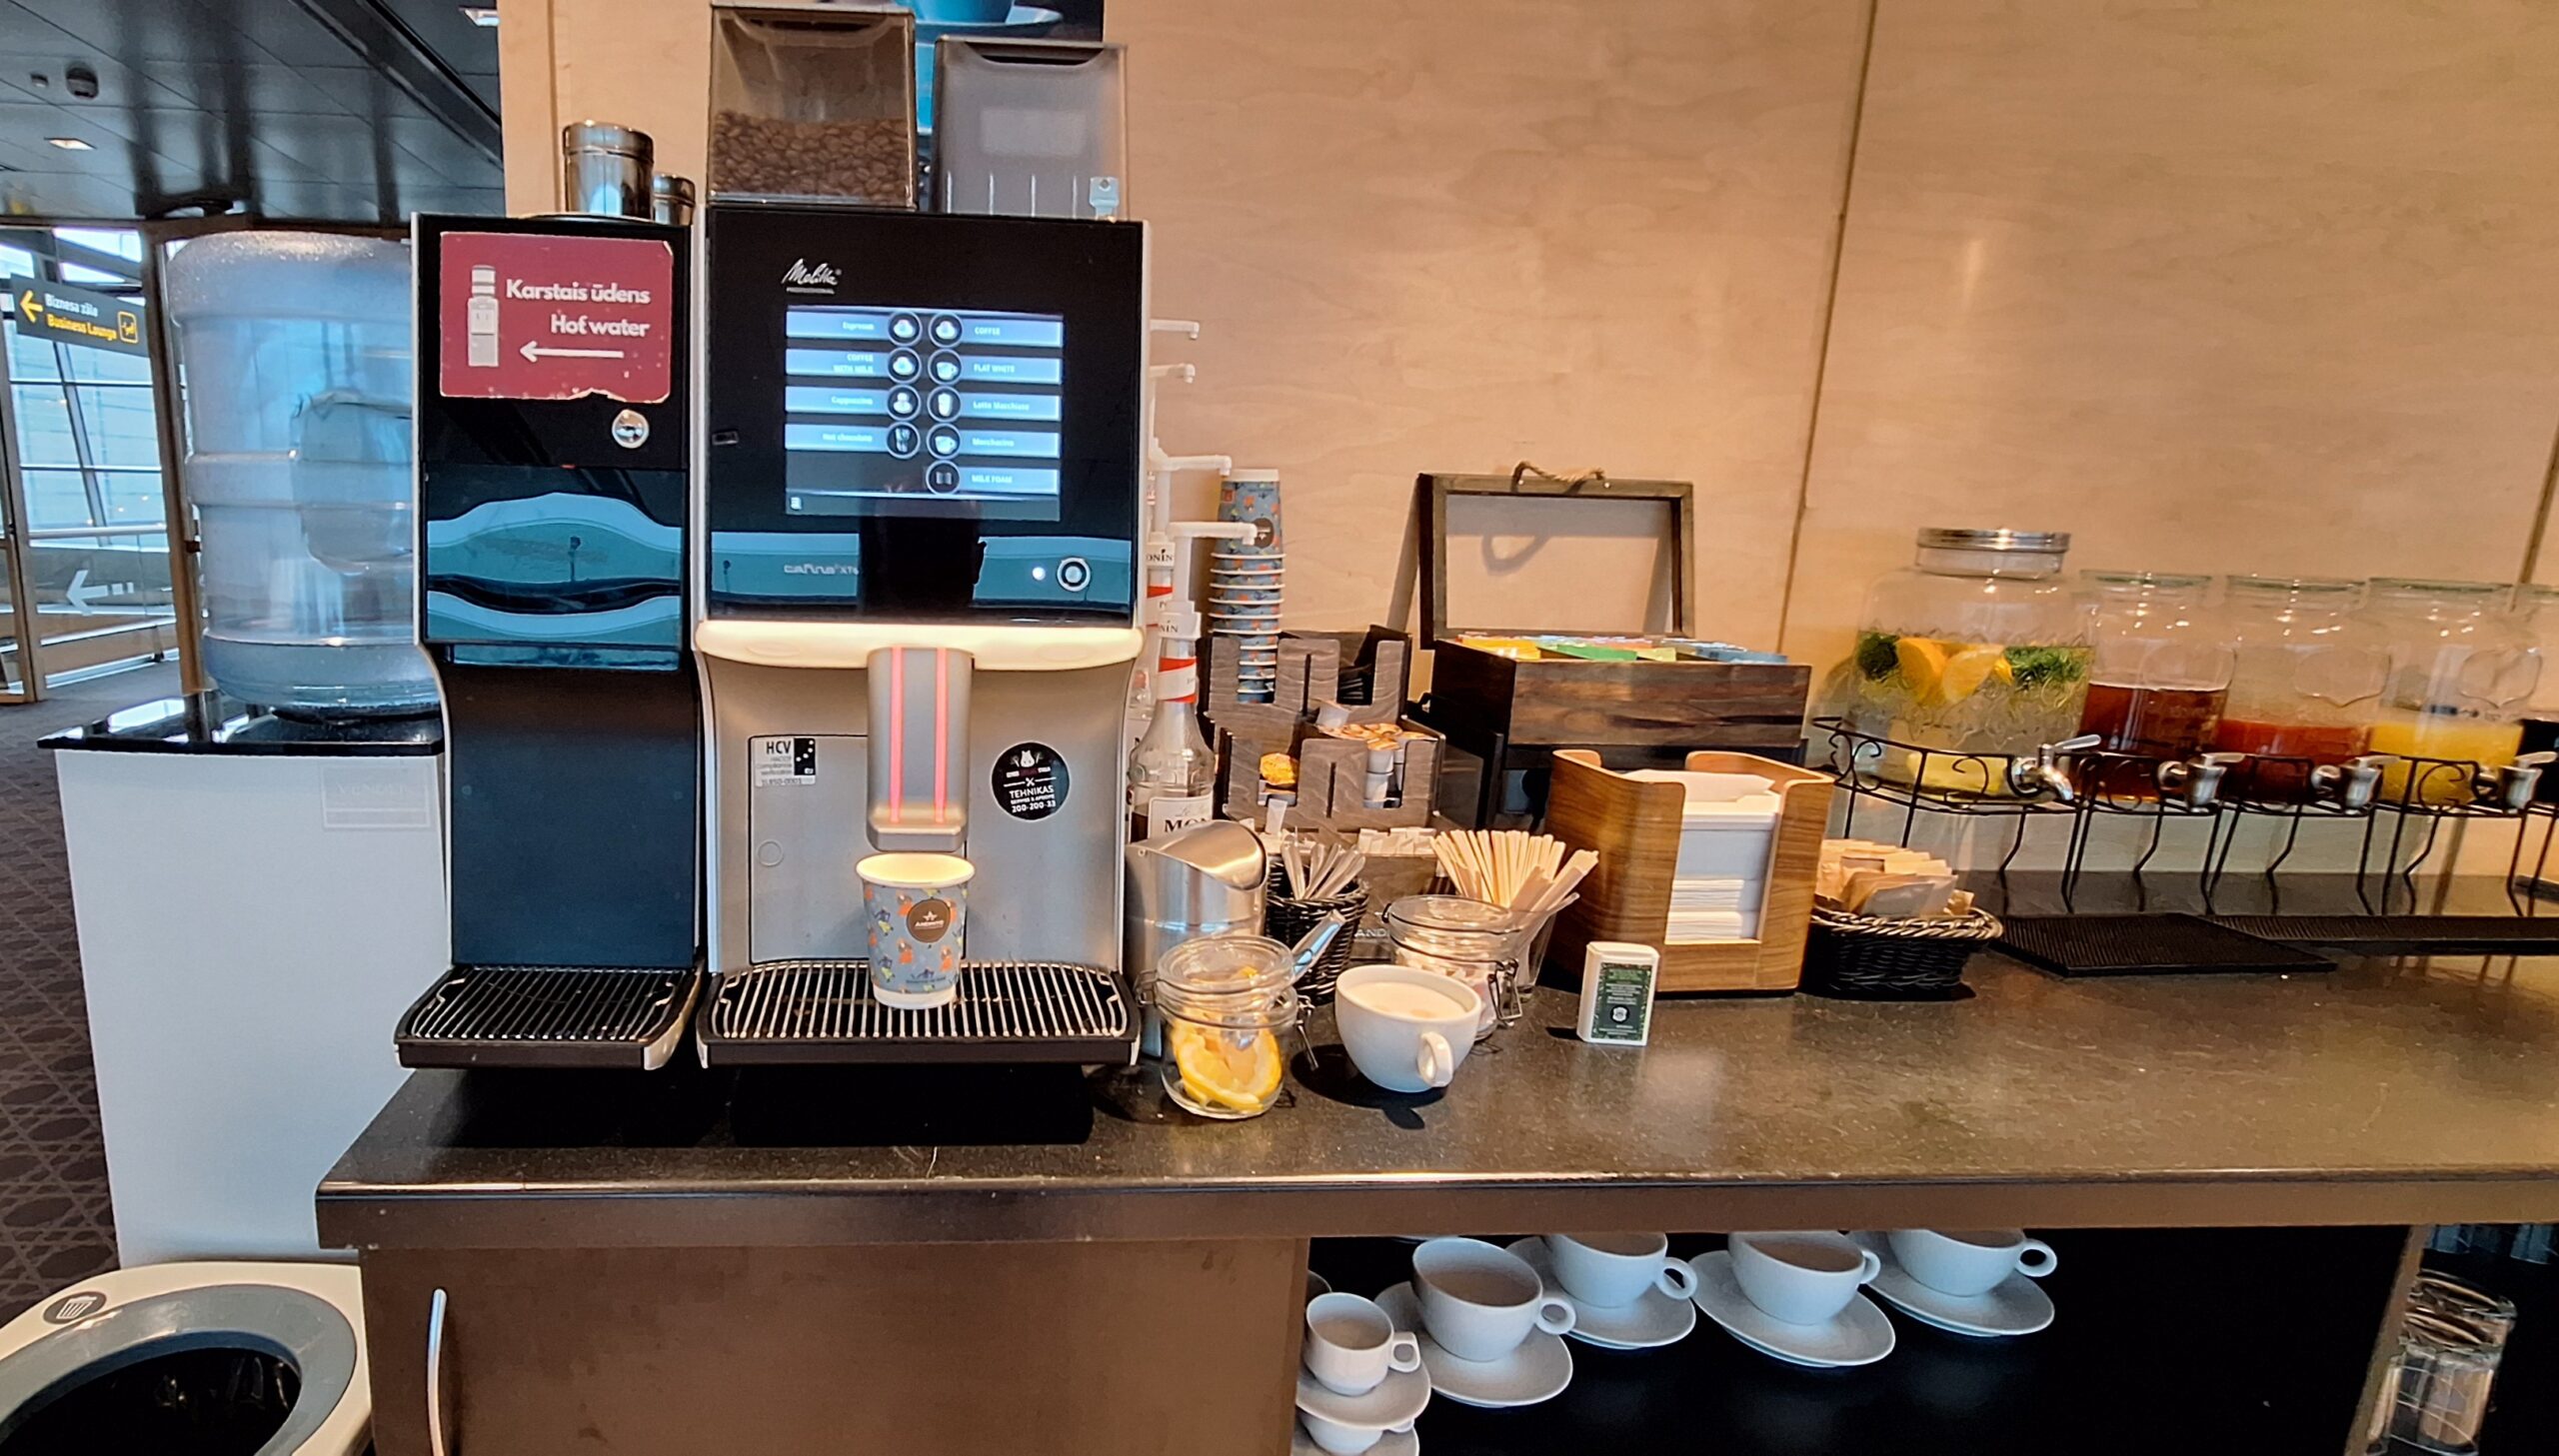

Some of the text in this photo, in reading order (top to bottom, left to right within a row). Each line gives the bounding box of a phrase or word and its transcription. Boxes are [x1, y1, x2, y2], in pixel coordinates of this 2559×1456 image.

[781, 258, 838, 286] Melitta
[506, 278, 651, 304] Karstais ūdens
[45, 293, 80, 313] Biznesa
[46, 313, 117, 341] Business Lounge
[588, 319, 651, 337] water
[766, 740, 792, 754] HCV
[1009, 784, 1055, 799] TEHNIKAS
